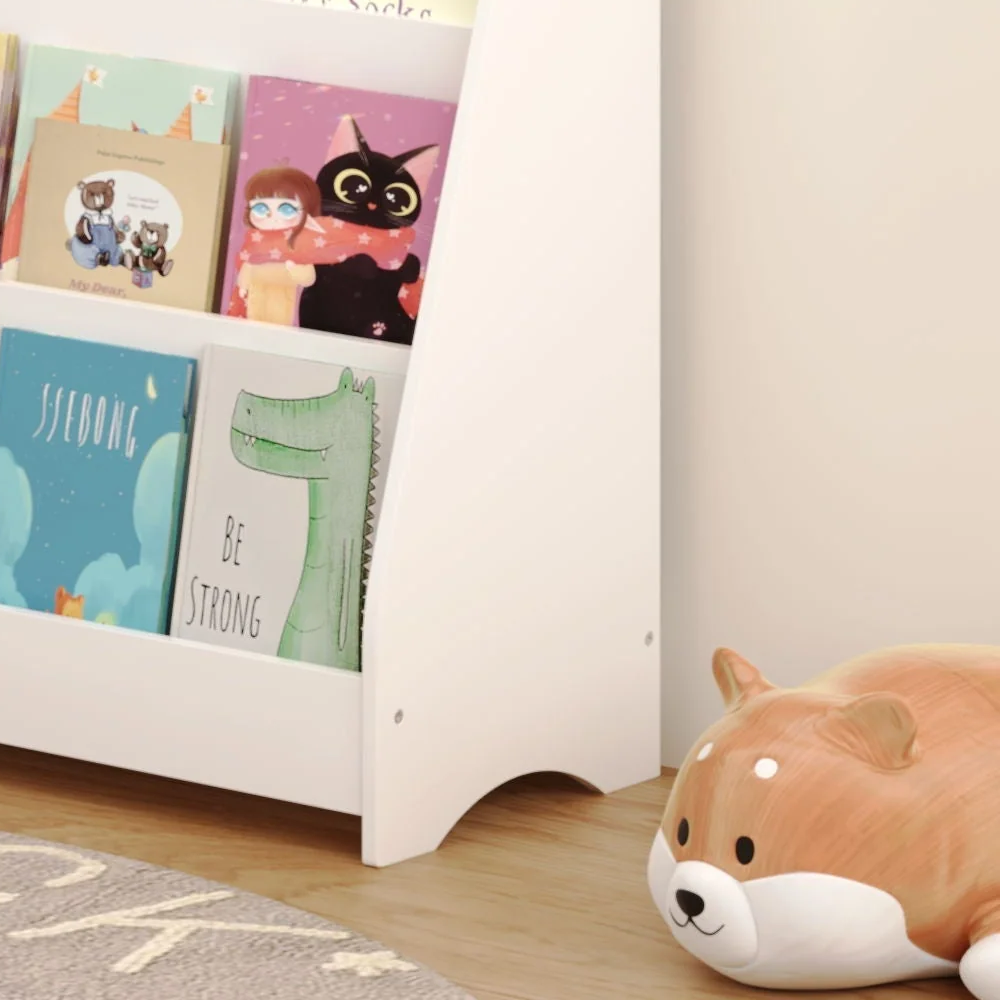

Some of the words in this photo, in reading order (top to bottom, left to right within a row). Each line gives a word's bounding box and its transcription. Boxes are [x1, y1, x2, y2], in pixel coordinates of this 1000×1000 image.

[32, 382, 140, 460] SSEBONG
[221, 514, 245, 567] BE
[186, 575, 262, 639] STRONG
